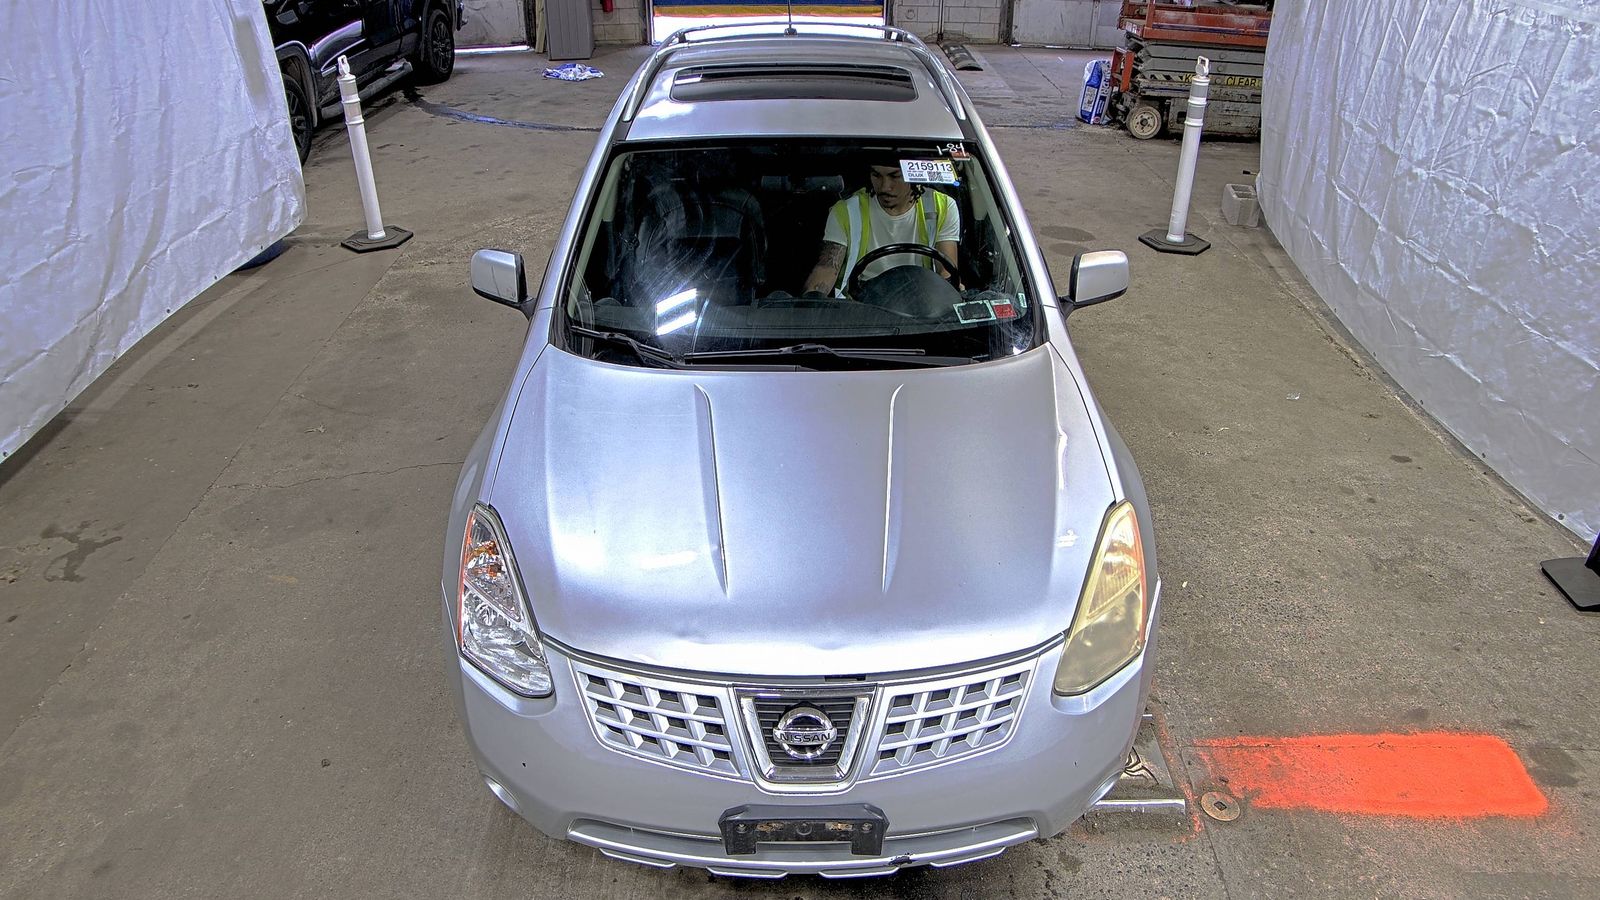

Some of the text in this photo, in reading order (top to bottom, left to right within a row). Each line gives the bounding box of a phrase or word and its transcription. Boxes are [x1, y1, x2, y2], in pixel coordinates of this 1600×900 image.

[1226, 76, 1257, 87] CLEAR
[907, 161, 953, 172] 2159113
[780, 733, 830, 742] NISSAN
